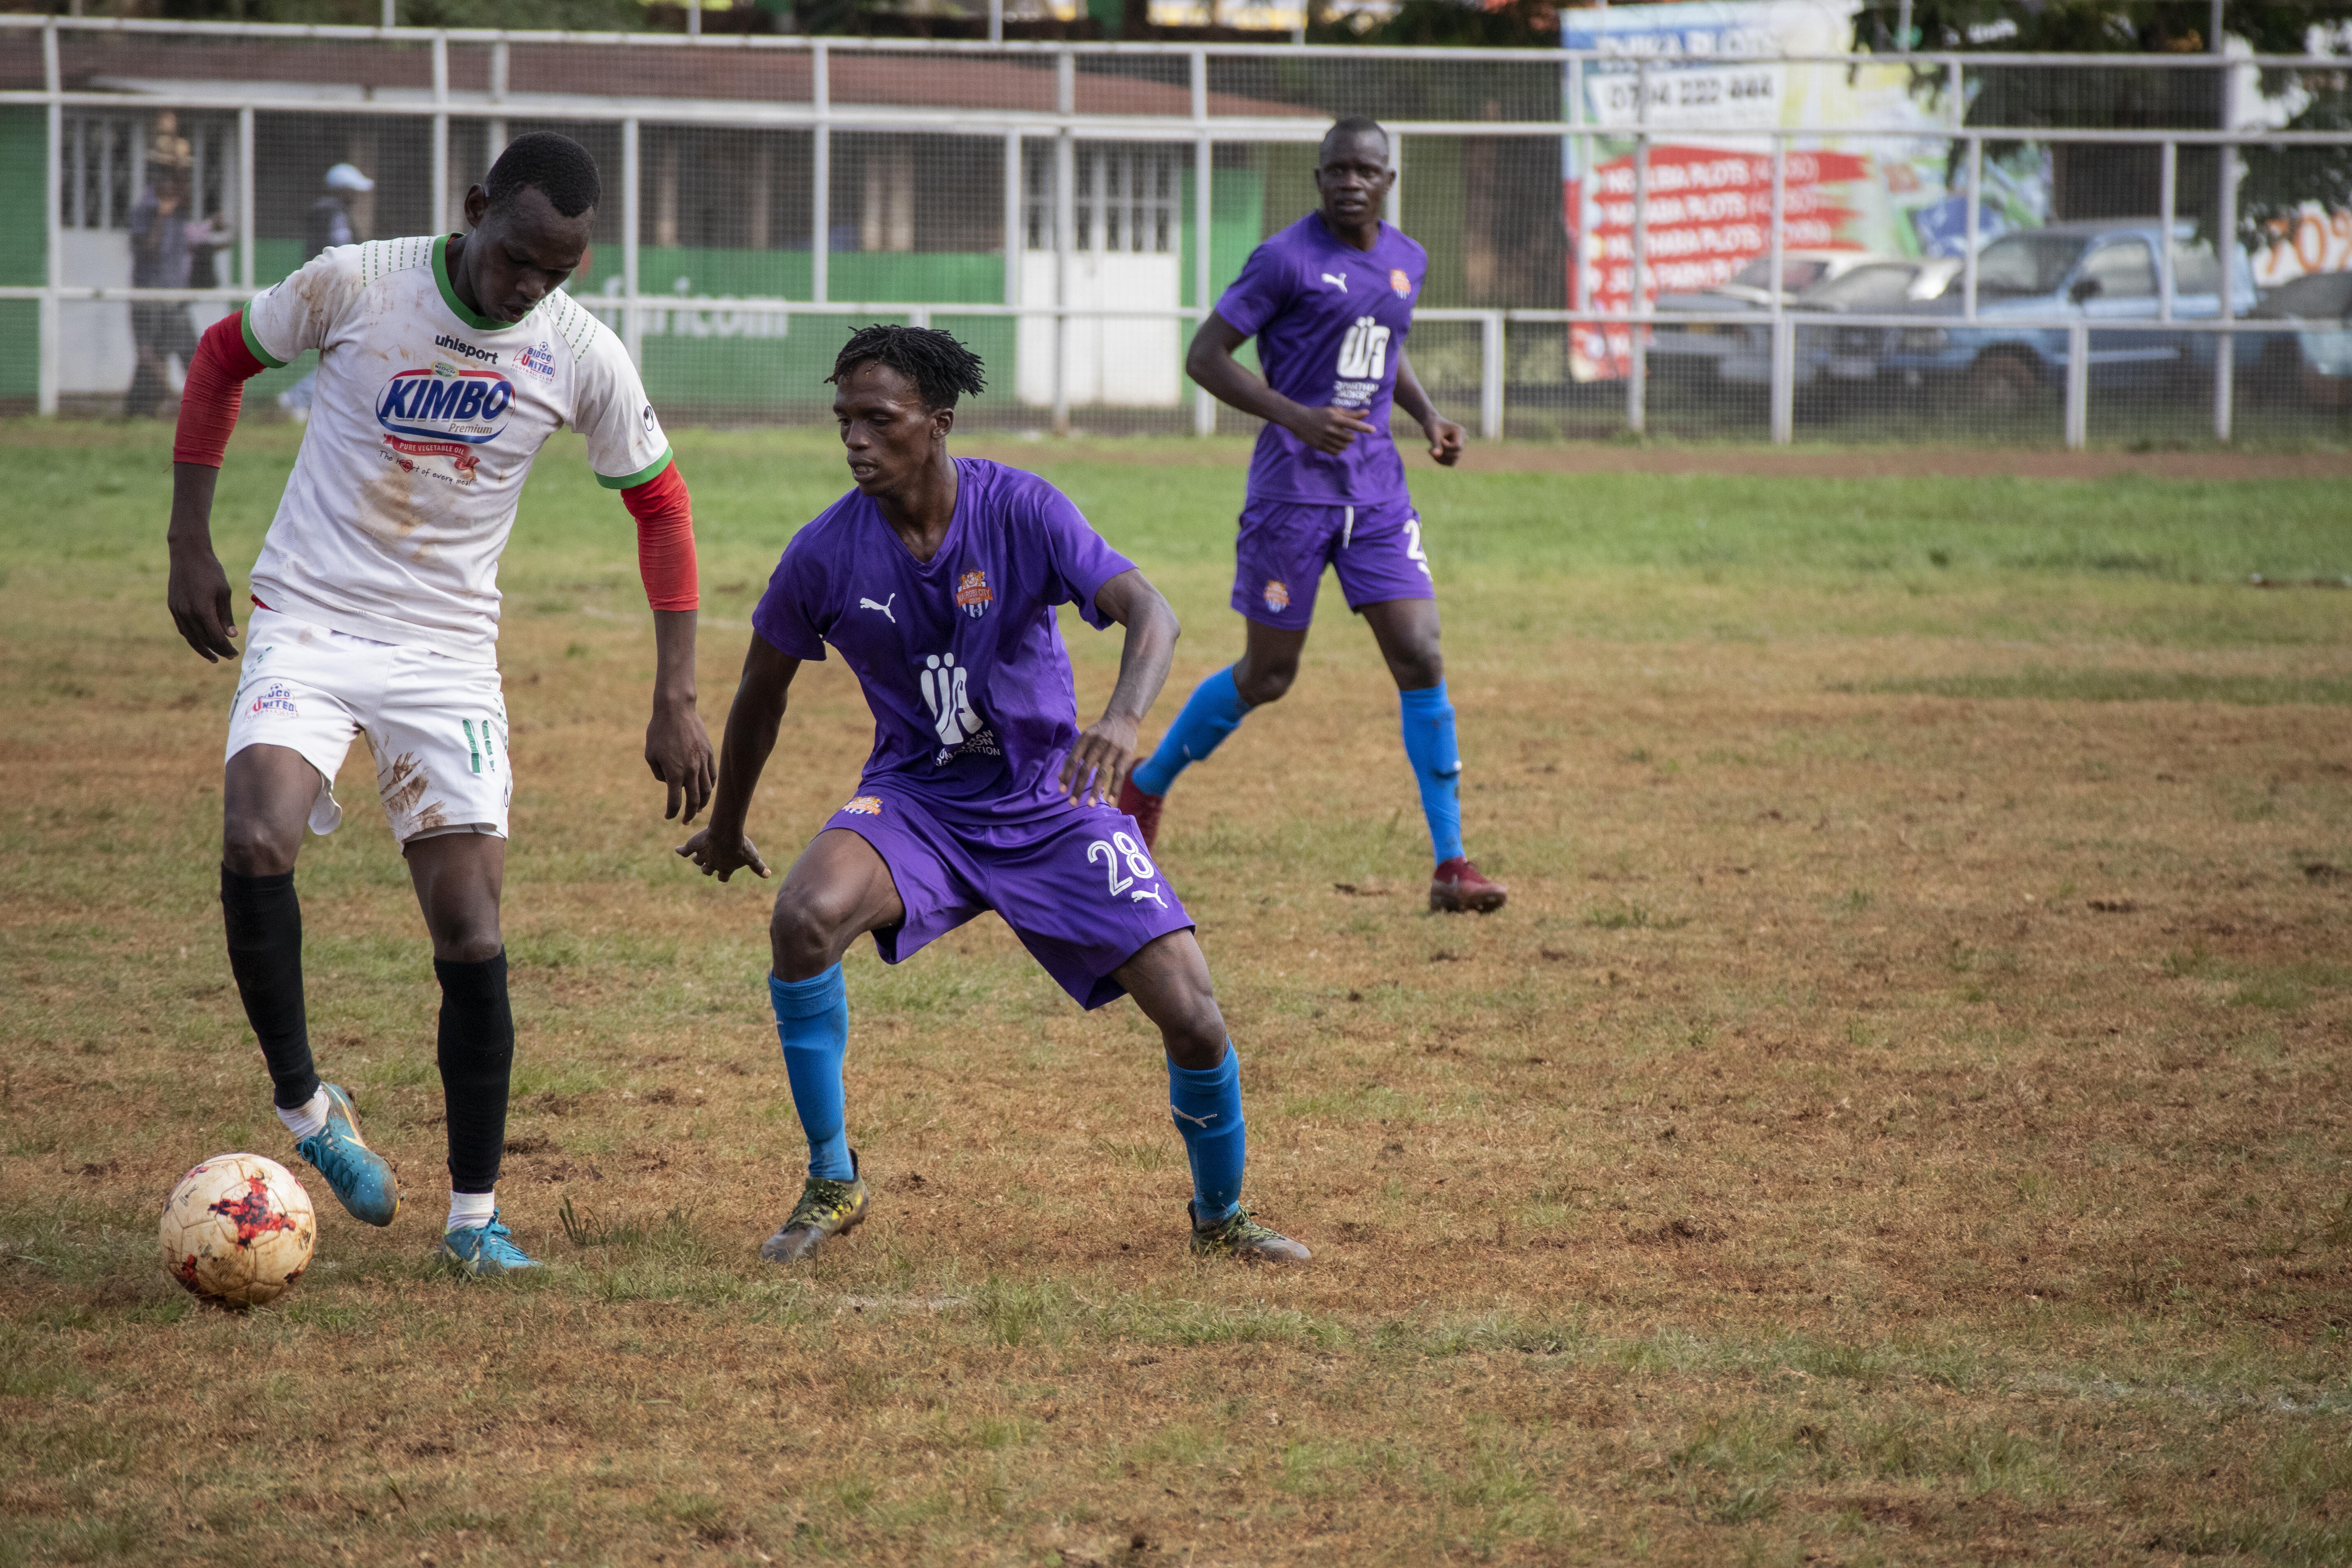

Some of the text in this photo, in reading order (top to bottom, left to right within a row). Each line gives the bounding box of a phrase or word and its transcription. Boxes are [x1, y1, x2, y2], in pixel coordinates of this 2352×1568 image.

[1689, 161, 1748, 187] PLOTS
[1686, 192, 1746, 221] PLOTS
[1700, 224, 1761, 252] PLOTS
[435, 335, 499, 365] uhlsport
[527, 347, 552, 362] BIDCO
[435, 364, 456, 374] BIDCO
[511, 363, 537, 377] FOOTBALL
[521, 354, 554, 375] UNITED
[379, 379, 512, 421] KIMBO
[449, 423, 493, 434] Premium
[400, 442, 464, 456] PURE VEGETABLE OIL
[380, 450, 393, 461] The
[422, 468, 430, 477] of
[432, 473, 453, 484] every
[456, 479, 473, 487] meal
[957, 589, 978, 603] NAIROBI
[253, 700, 294, 712] UNITED
[1087, 831, 1154, 896] 28
